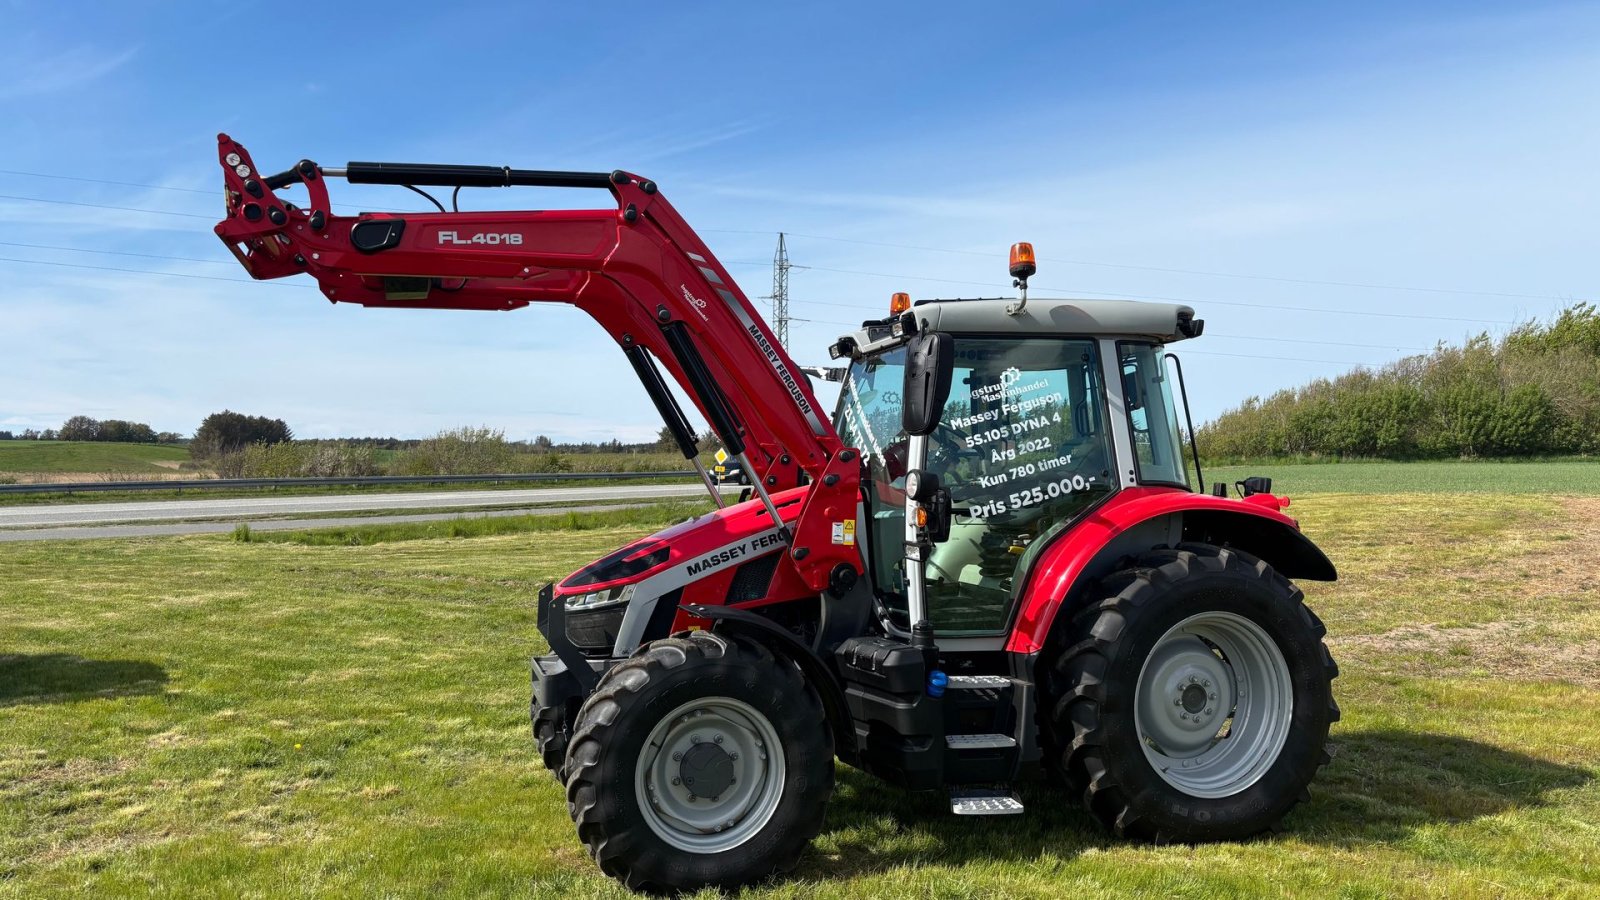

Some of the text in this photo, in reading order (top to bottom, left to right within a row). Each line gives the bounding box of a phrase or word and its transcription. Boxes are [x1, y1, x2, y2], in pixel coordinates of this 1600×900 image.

[438, 231, 523, 245] FL.4018
[748, 324, 812, 415] MASSEY FERGUSON
[981, 379, 1049, 404] Maskinhandel
[950, 391, 1062, 431] Massey Ferguson
[964, 412, 1062, 448] 5S.105 DYNA 4
[991, 436, 1052, 464] Årg 2022
[979, 454, 1072, 488] Kun 780 timer
[969, 474, 1096, 519] Pris 525.000,-
[686, 531, 785, 577] MASSEY FERG
